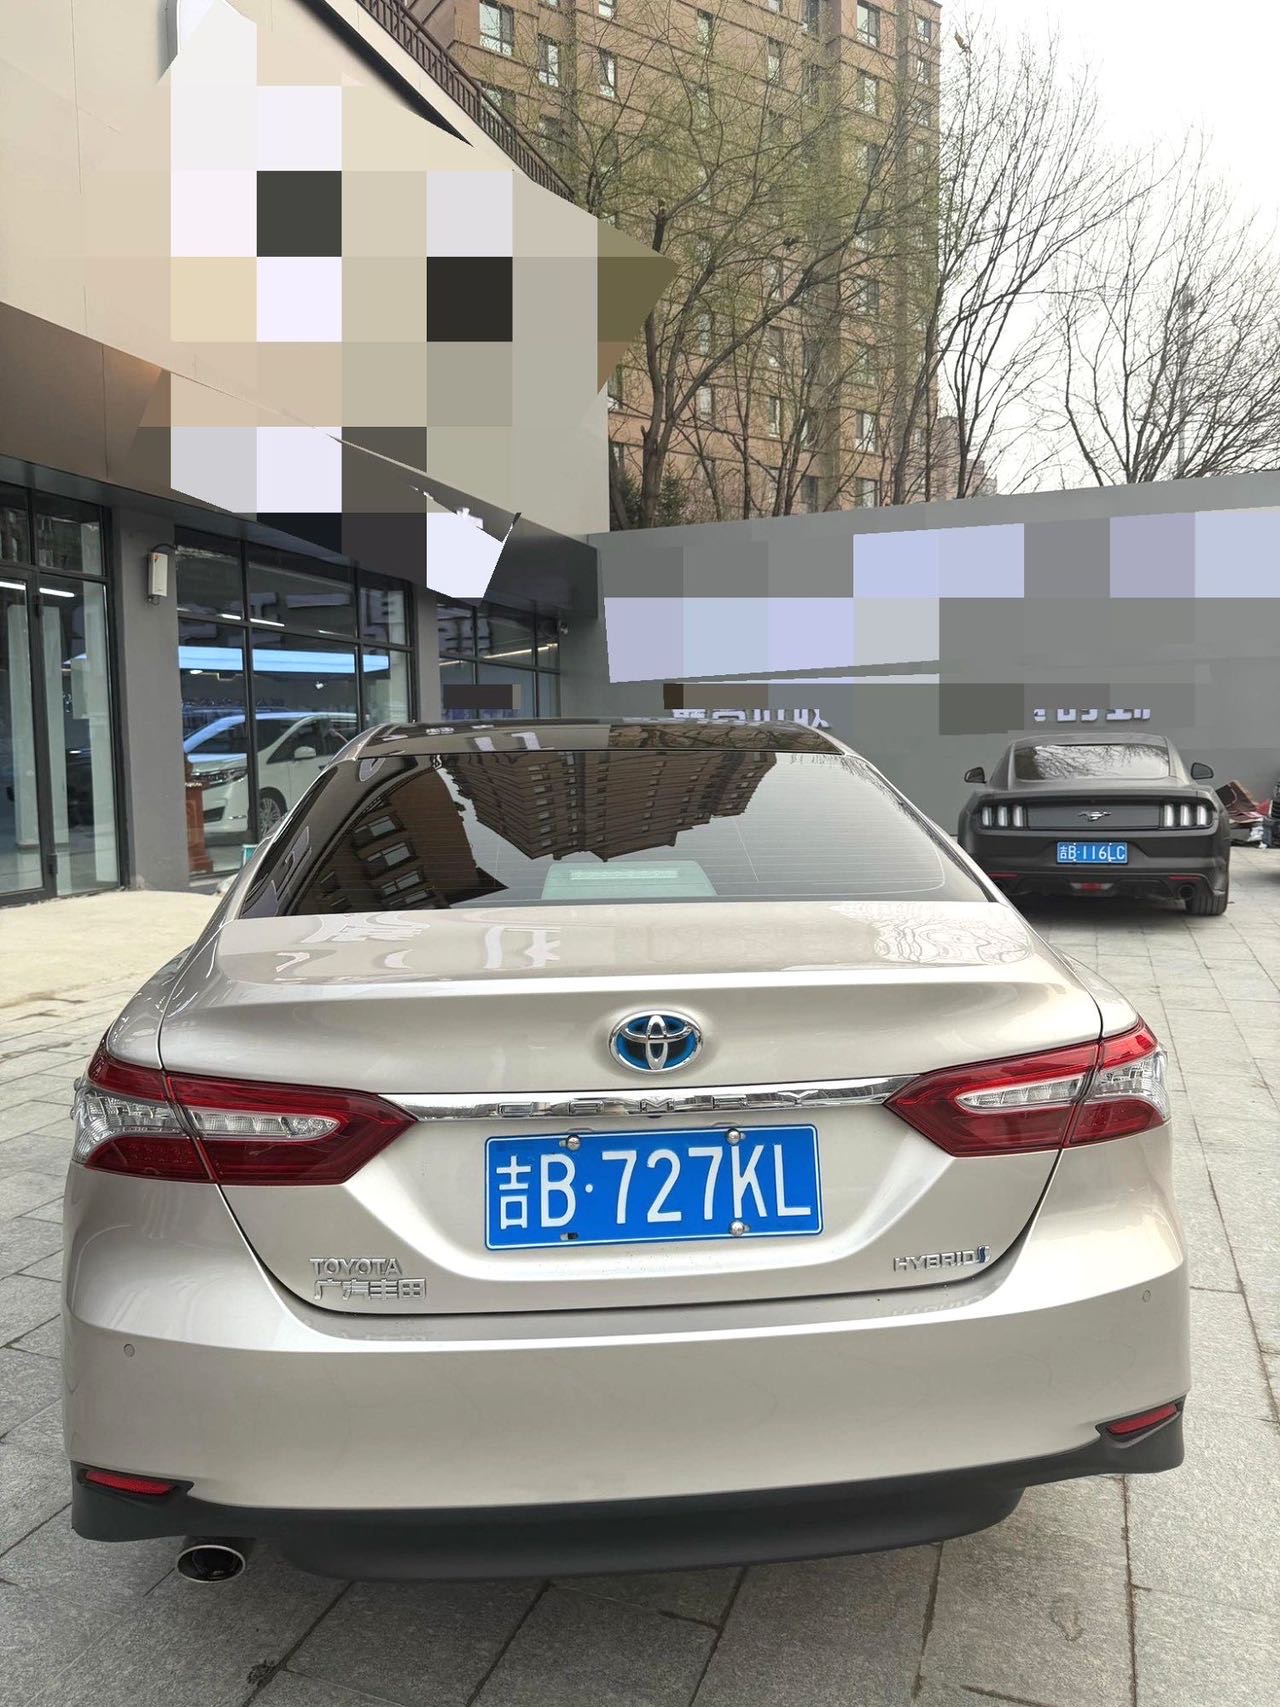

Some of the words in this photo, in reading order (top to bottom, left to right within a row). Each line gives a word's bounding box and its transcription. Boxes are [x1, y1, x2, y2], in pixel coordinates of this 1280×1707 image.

[496, 1144, 812, 1230] 吉B·727KL
[309, 1258, 402, 1276] TOYOTA
[893, 1250, 976, 1272] HYBRID
[313, 1278, 426, 1301] 广汽丰田
